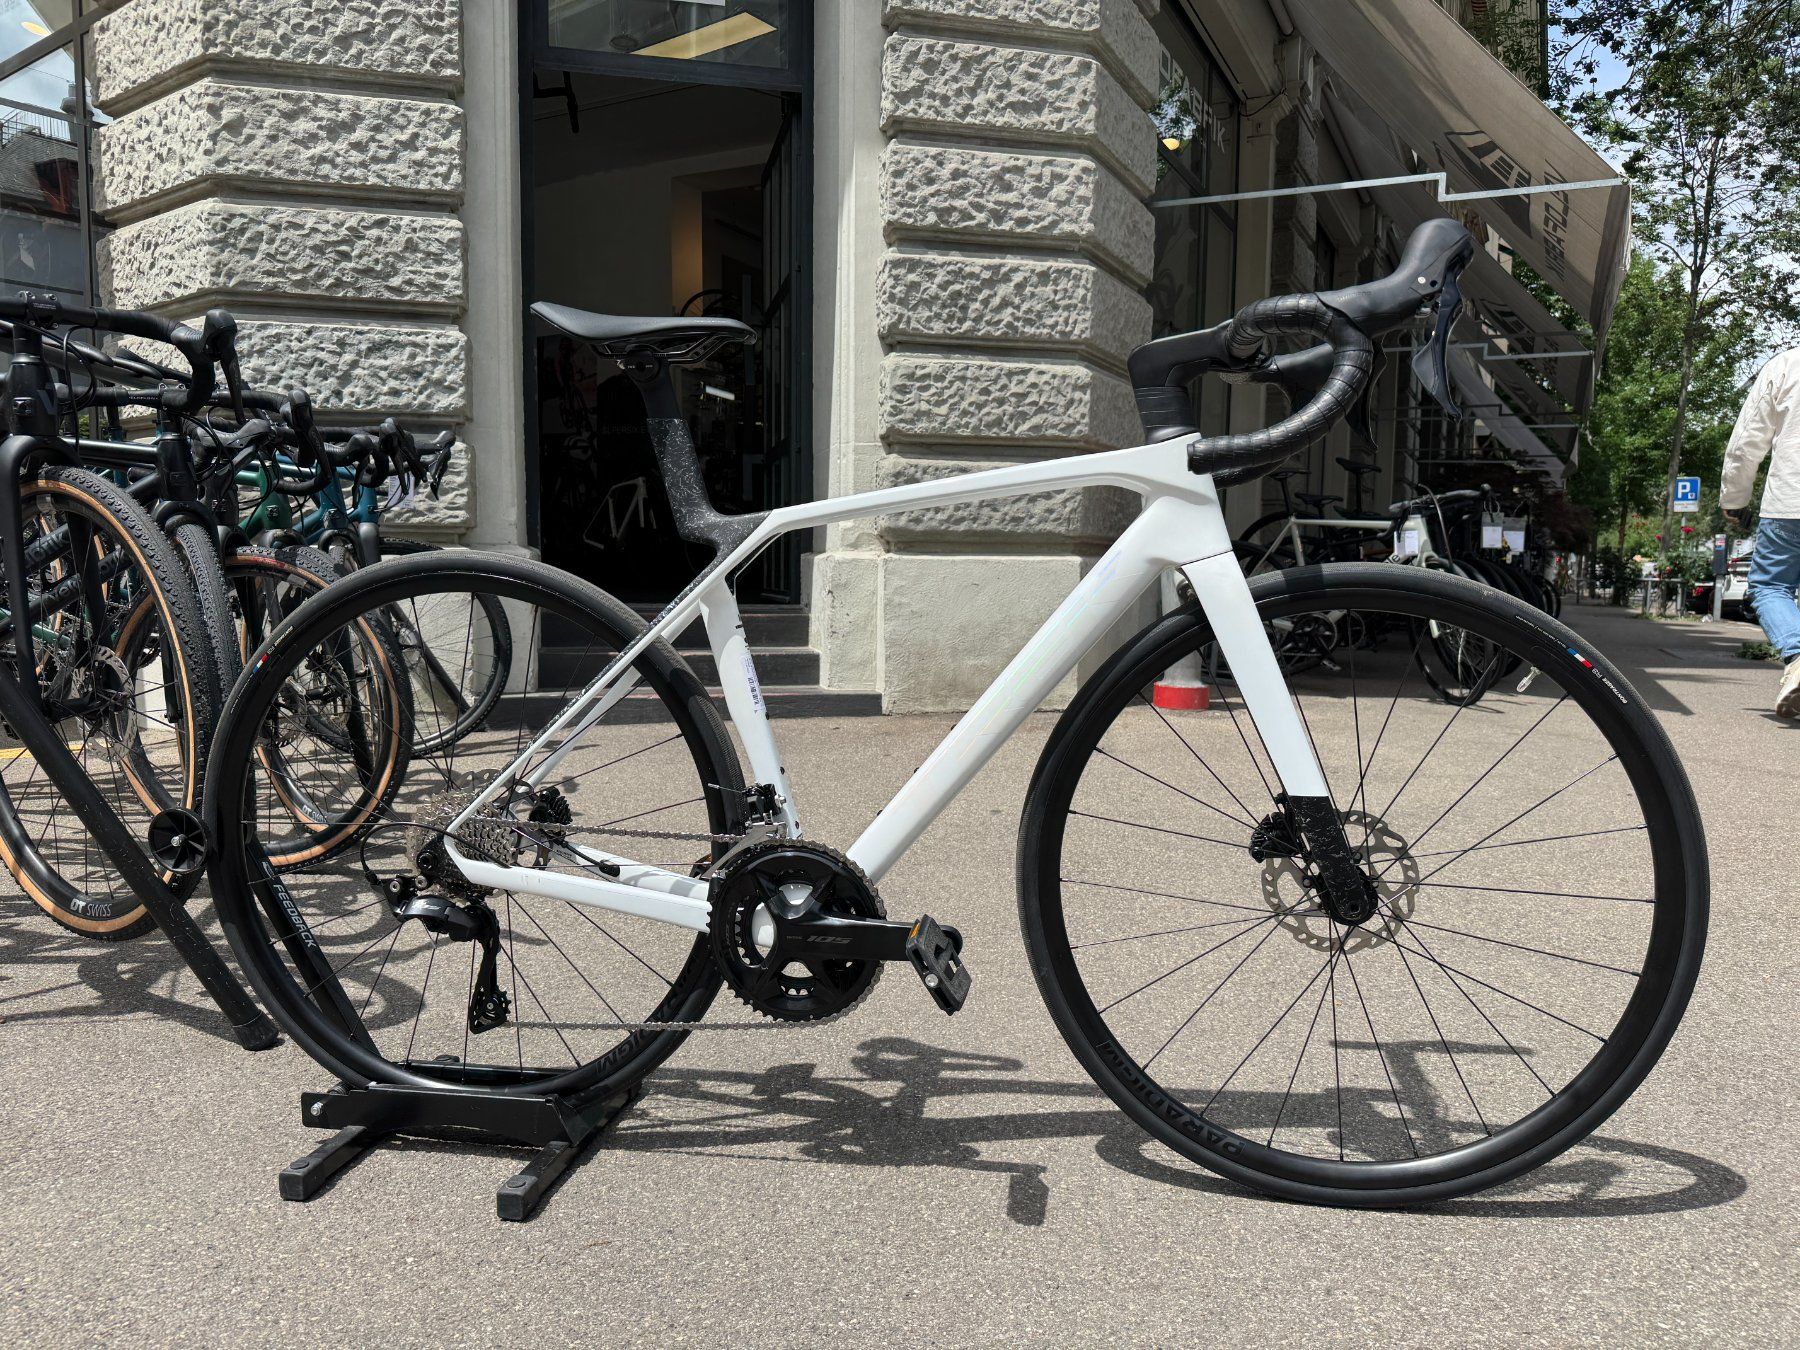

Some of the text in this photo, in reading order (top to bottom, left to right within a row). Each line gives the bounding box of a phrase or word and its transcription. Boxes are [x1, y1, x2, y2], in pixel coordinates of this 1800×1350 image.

[1677, 481, 1691, 499] P
[70, 897, 113, 917] DT SWISS
[272, 884, 317, 948] FEEDBACK
[806, 935, 853, 945] 105
